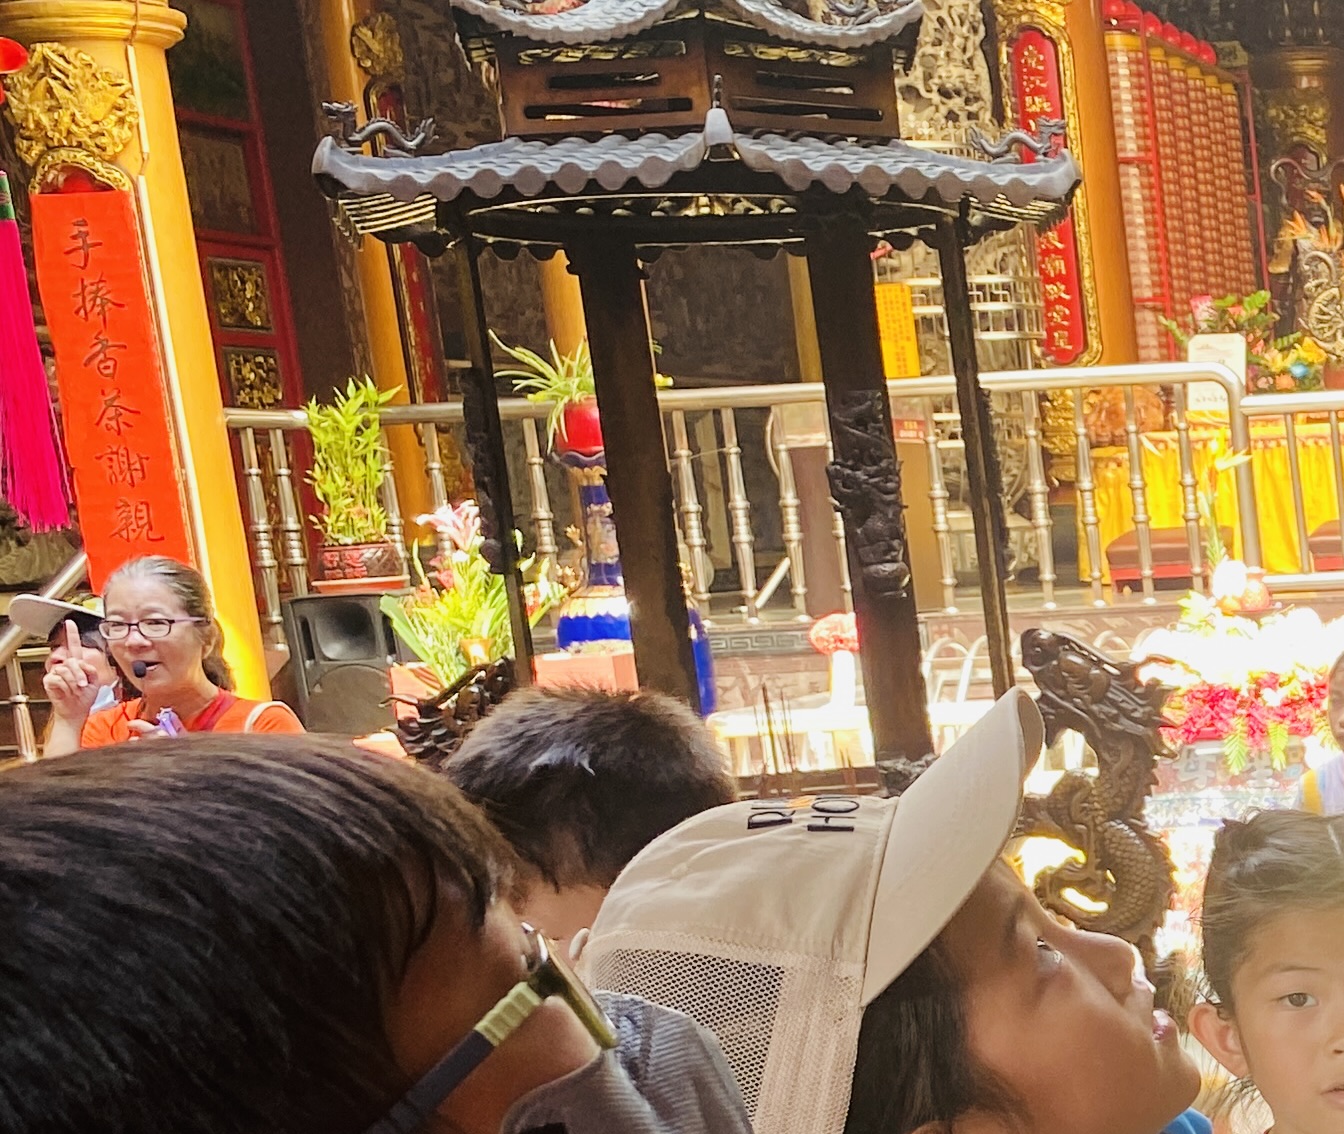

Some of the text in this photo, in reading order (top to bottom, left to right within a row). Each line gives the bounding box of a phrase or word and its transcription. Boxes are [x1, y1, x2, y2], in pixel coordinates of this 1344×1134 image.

[64, 218, 165, 558] 手捧香茶謝親
